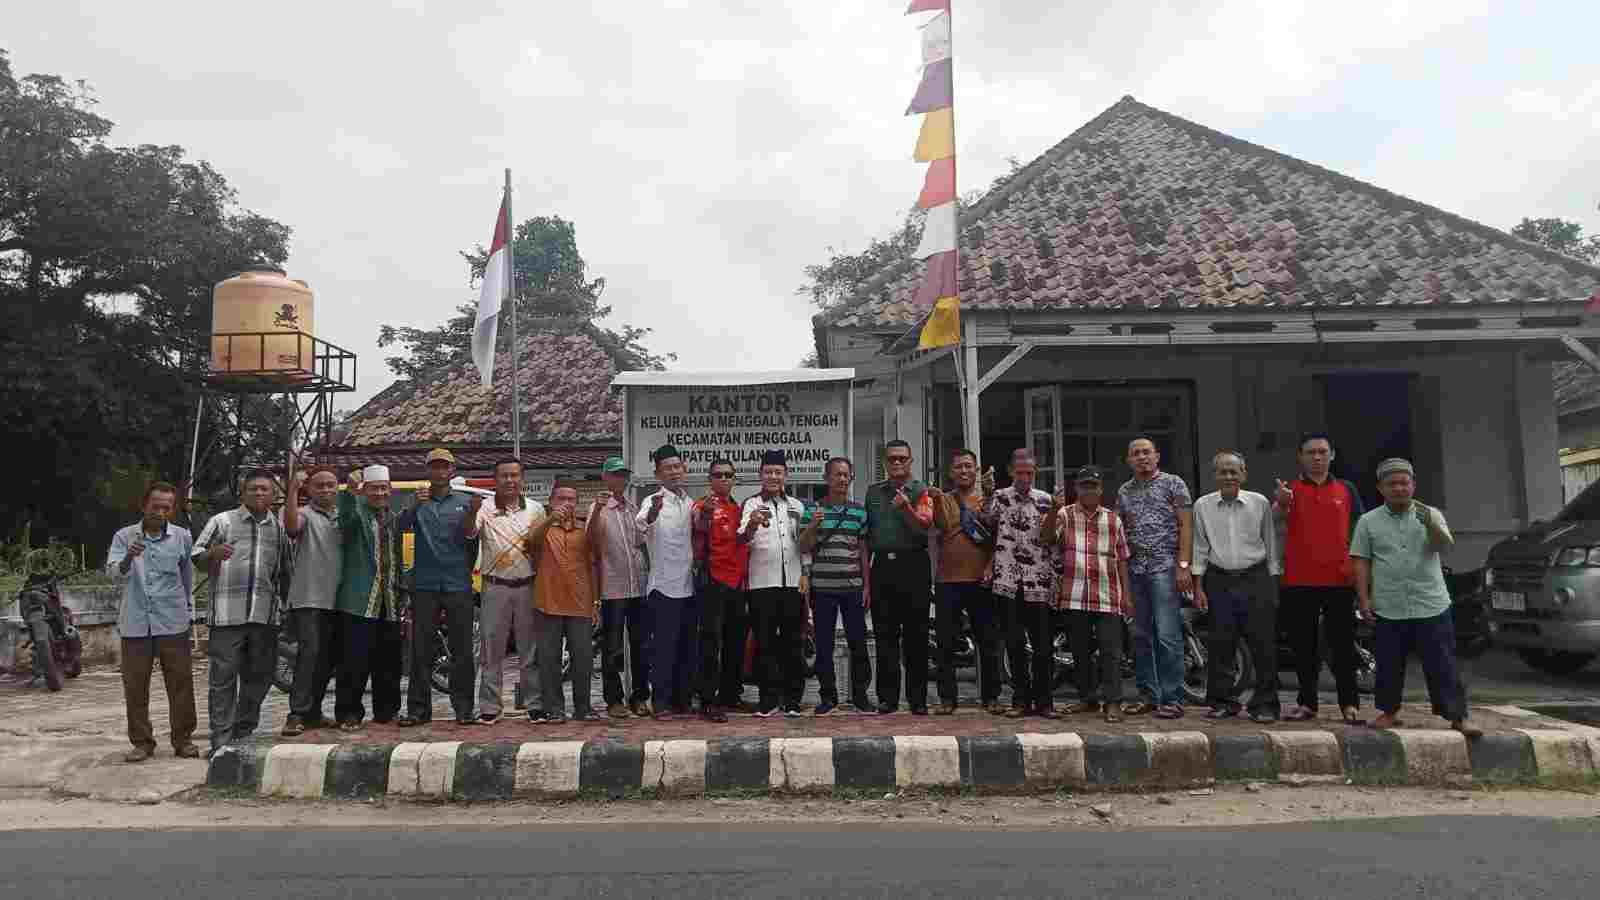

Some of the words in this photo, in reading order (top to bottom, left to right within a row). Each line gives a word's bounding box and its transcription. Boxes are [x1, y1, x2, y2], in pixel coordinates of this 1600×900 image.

[689, 394, 791, 413] KANTOR
[641, 415, 714, 429] KELURAHAN
[718, 414, 785, 428] MENGGALA
[790, 414, 839, 427] TENGAH
[667, 433, 741, 446] KECAMATAN
[745, 432, 812, 445] MENGGALA
[649, 450, 720, 463] KPATEN
[723, 449, 770, 462] TULAN
[782, 448, 830, 461] AWANG
